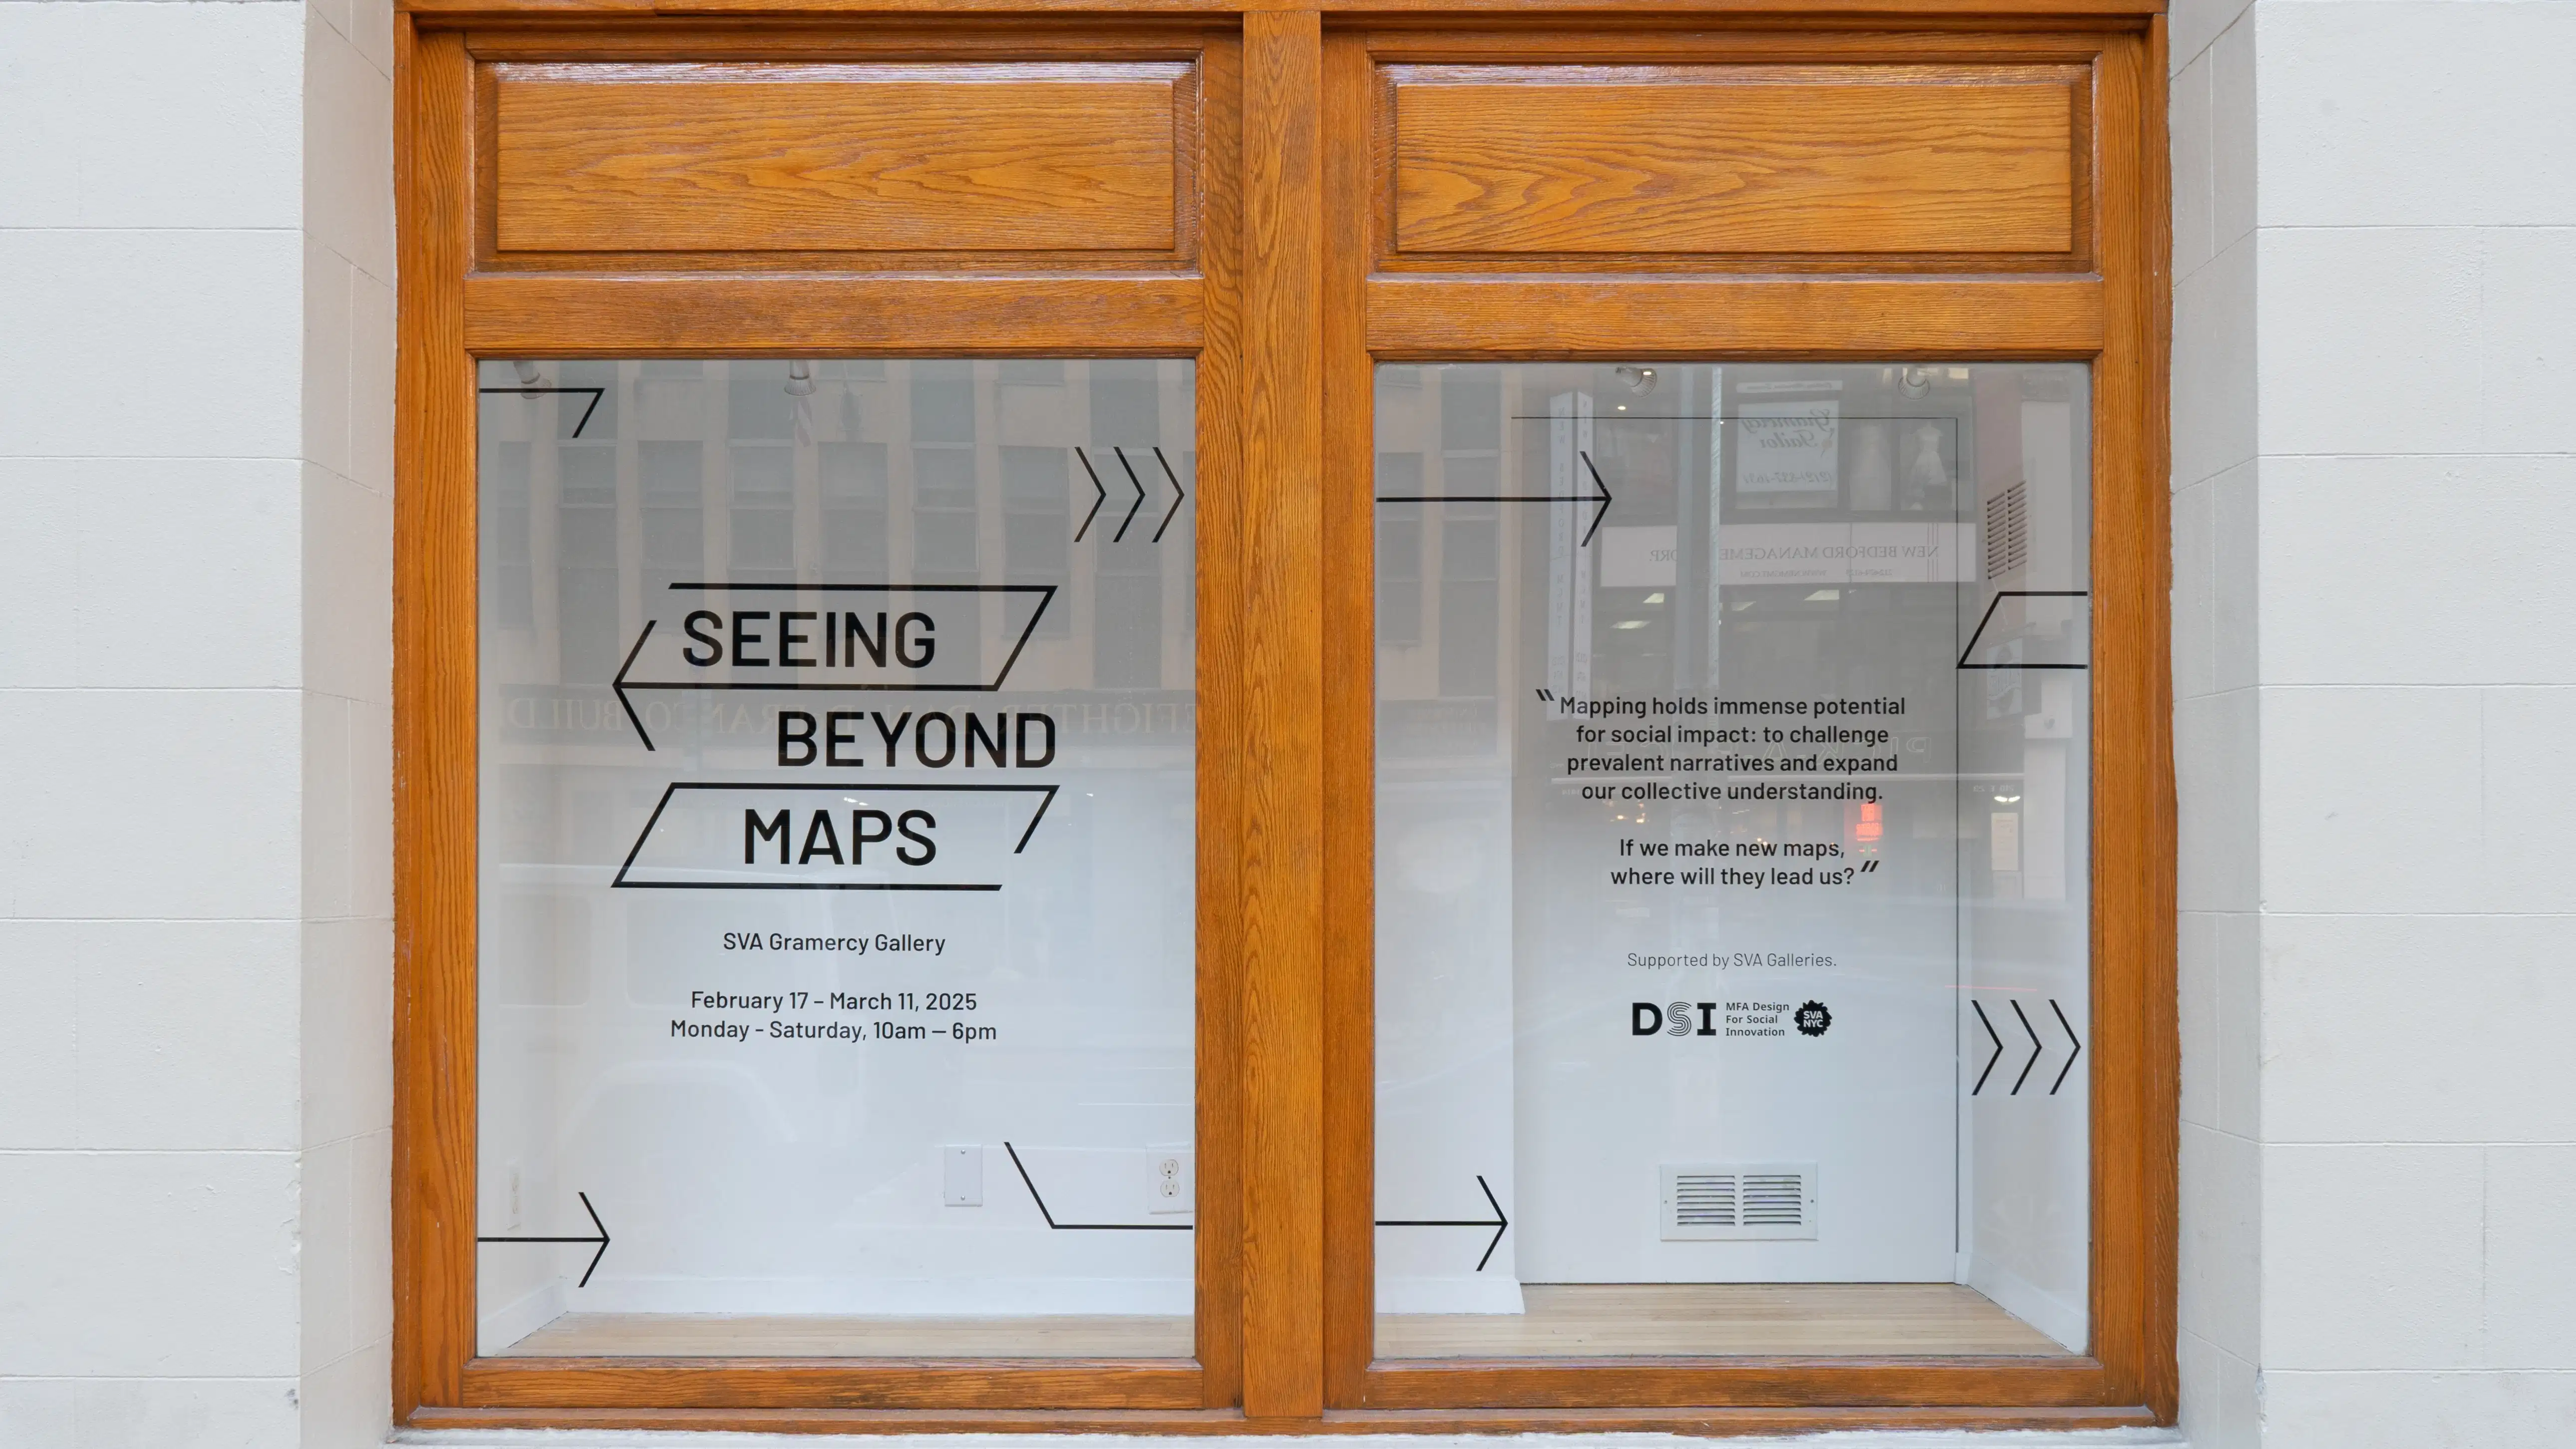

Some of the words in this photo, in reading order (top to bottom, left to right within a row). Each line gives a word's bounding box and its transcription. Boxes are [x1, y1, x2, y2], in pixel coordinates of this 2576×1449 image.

[683, 610, 935, 669] SEEING
[1652, 697, 1708, 715] holds
[1714, 696, 1808, 715] immense
[1814, 696, 1905, 719] potential
[778, 711, 1055, 769] BEYOND
[1576, 725, 1606, 743] for
[1611, 725, 1671, 743] social
[1678, 725, 1756, 747] impact:
[1763, 727, 1784, 743] to
[1790, 725, 1889, 748] challenge
[1568, 754, 1664, 775] prevalent
[1670, 753, 1774, 772] narratives
[1780, 754, 1817, 771] and
[1823, 754, 1898, 775] expand
[1582, 786, 1616, 800] our
[1621, 782, 1721, 800] collective
[1727, 782, 1883, 804] understanding.
[744, 809, 937, 867] MAPS
[1620, 839, 1634, 856] If
[1639, 843, 1668, 857] we
[1675, 839, 1730, 857] make
[1736, 843, 1778, 857] new
[1784, 843, 1845, 861] maps,
[1610, 867, 1675, 885] where
[1680, 867, 1714, 885] will
[1720, 868, 1765, 889] they
[1771, 867, 1813, 885] lead
[723, 932, 763, 950] SVA
[769, 933, 869, 956] Gramercy
[875, 933, 946, 956] Gallery
[1627, 953, 1708, 970] Supported
[1713, 953, 1730, 970] by
[1733, 953, 1763, 967] SVA
[1767, 953, 1837, 967] Galleries.
[692, 991, 784, 1014] February
[789, 992, 809, 1009] 17
[830, 992, 892, 1010] March
[898, 992, 919, 1012] 11,
[926, 993, 977, 1011] 2025
[1726, 1002, 1749, 1011] MFA
[1753, 1002, 1789, 1012] Design
[1632, 1001, 1717, 1037] DSI
[1726, 1015, 1743, 1024] For
[1747, 1014, 1778, 1024] Social
[1803, 1010, 1823, 1019] SVA
[671, 1020, 750, 1043] Monday
[769, 1020, 867, 1043] Saturday,
[873, 1021, 926, 1039] 10am
[953, 1022, 996, 1044] 6pm
[1725, 1027, 1785, 1036] Innovation
